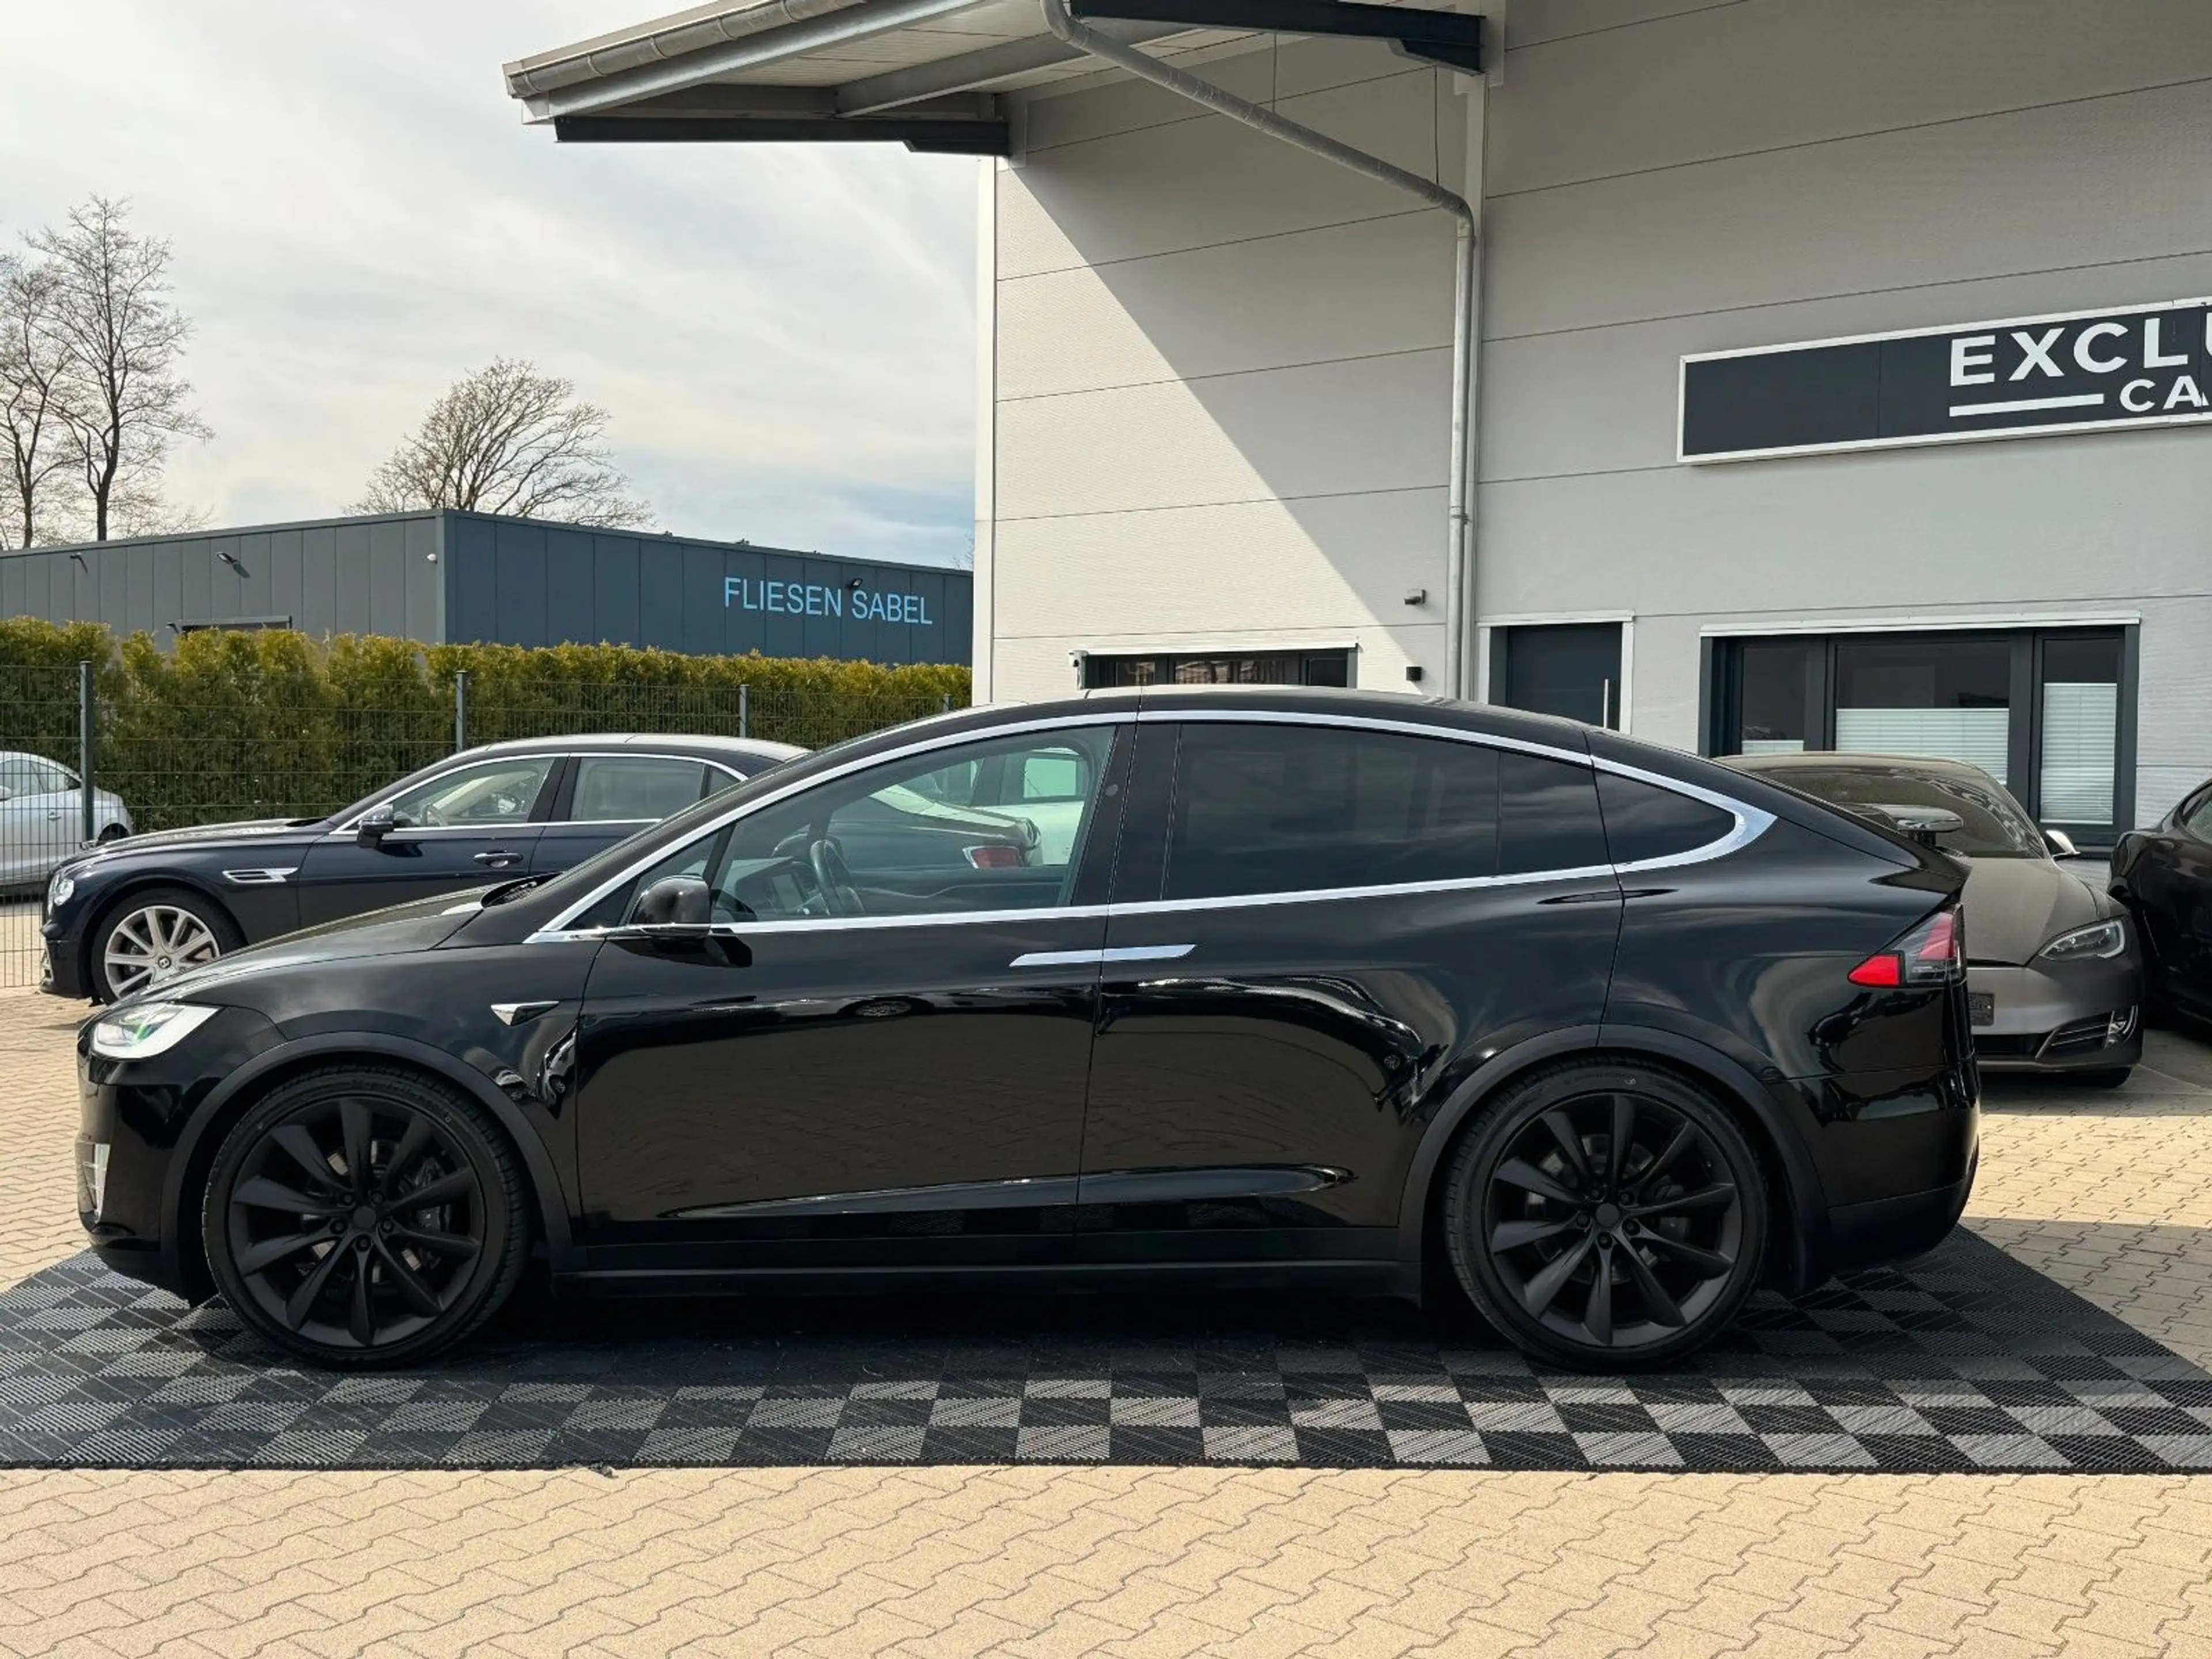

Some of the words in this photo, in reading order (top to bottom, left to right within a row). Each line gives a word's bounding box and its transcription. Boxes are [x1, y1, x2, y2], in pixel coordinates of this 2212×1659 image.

[1950, 312, 2212, 387] EXCL
[724, 577, 842, 618] FLIESEN
[851, 590, 933, 625] SABEL
